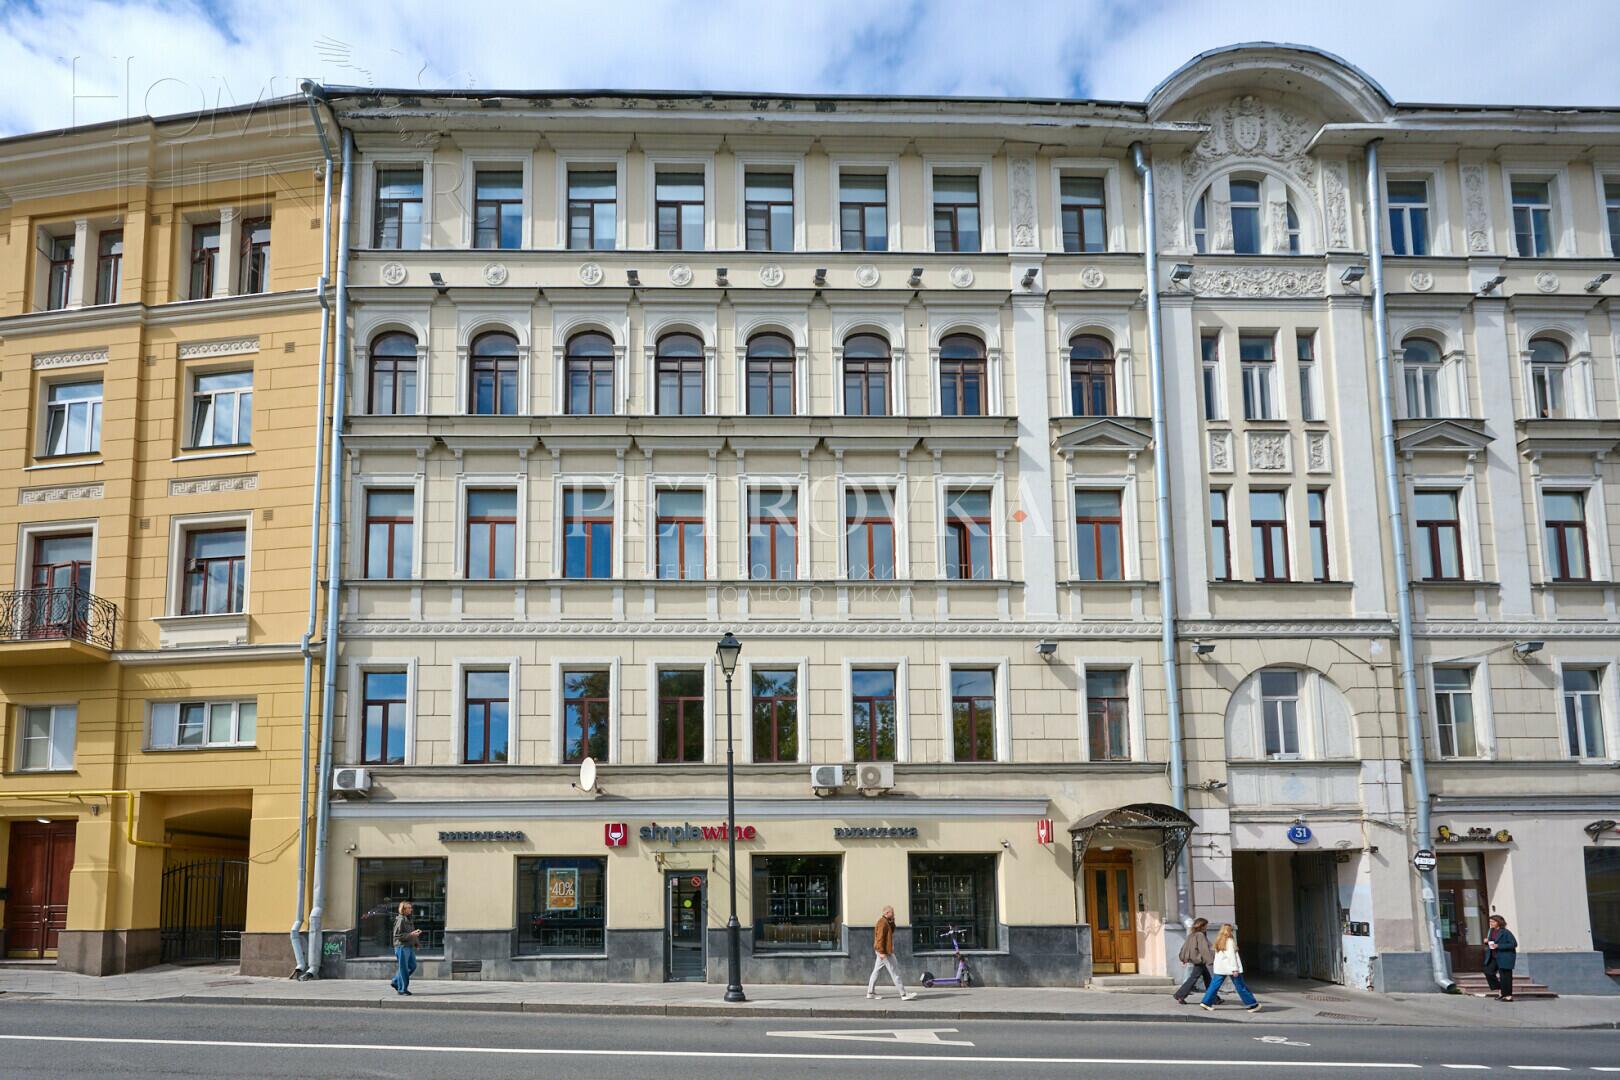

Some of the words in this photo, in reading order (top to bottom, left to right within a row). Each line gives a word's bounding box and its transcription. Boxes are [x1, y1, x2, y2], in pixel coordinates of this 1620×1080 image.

[639, 821, 757, 847] simplewine
[1295, 827, 1307, 838] 31
[551, 881, 575, 896] 40%
